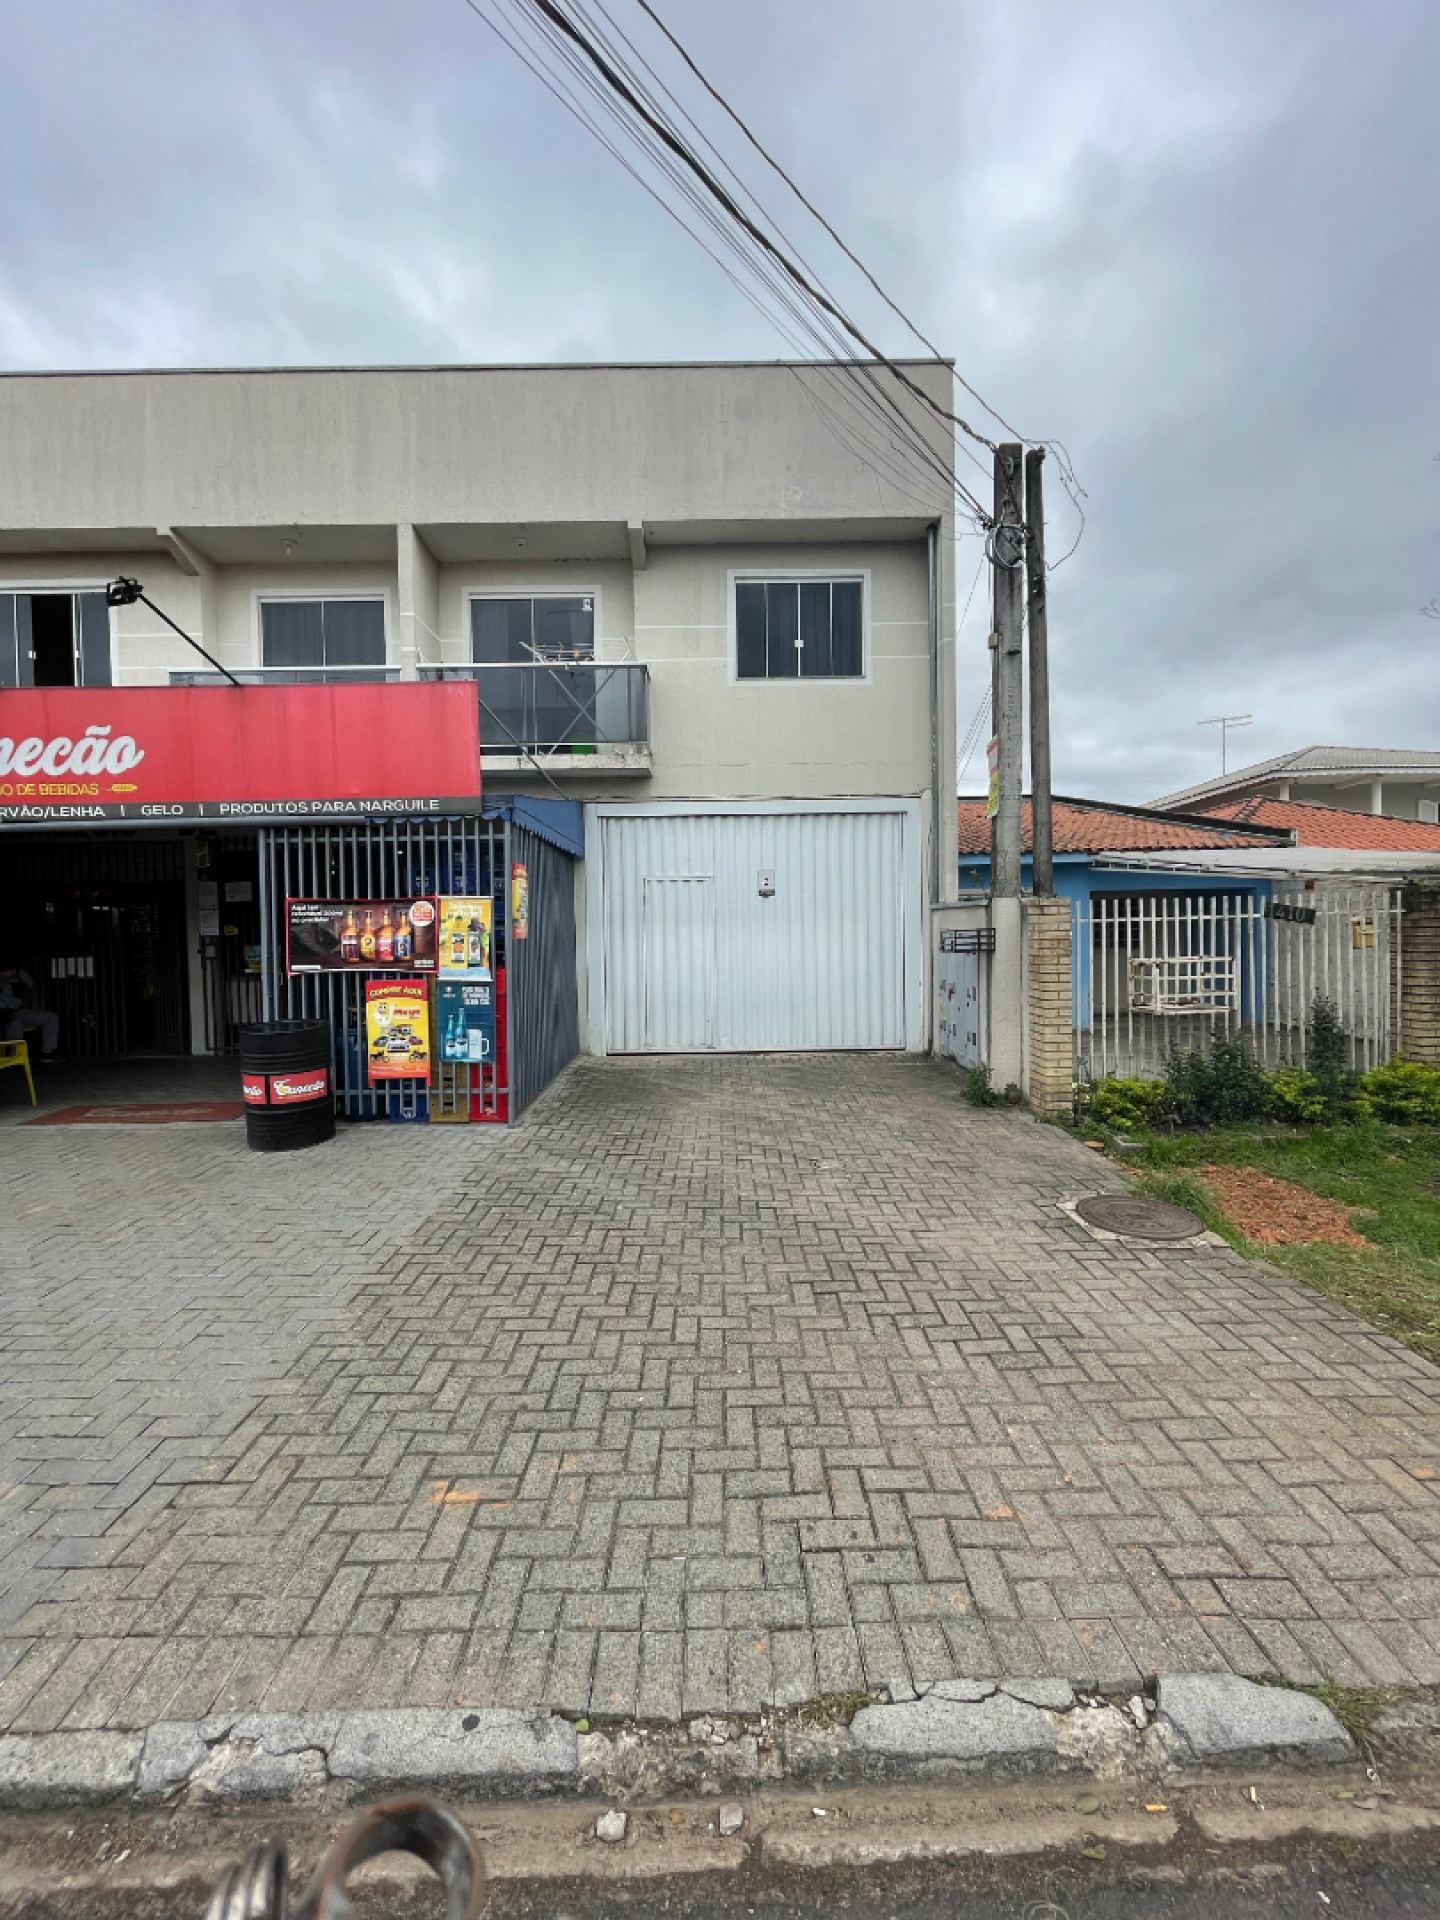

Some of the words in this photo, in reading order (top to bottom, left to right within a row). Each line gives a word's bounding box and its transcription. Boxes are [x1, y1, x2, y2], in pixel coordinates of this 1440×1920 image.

[16, 783, 37, 796] DE
[39, 782, 99, 796] BEBIDAS
[141, 804, 184, 816] GELO
[219, 801, 309, 815] PRODUTOS
[312, 801, 357, 813] PARA
[360, 799, 440, 812] NARGUILE
